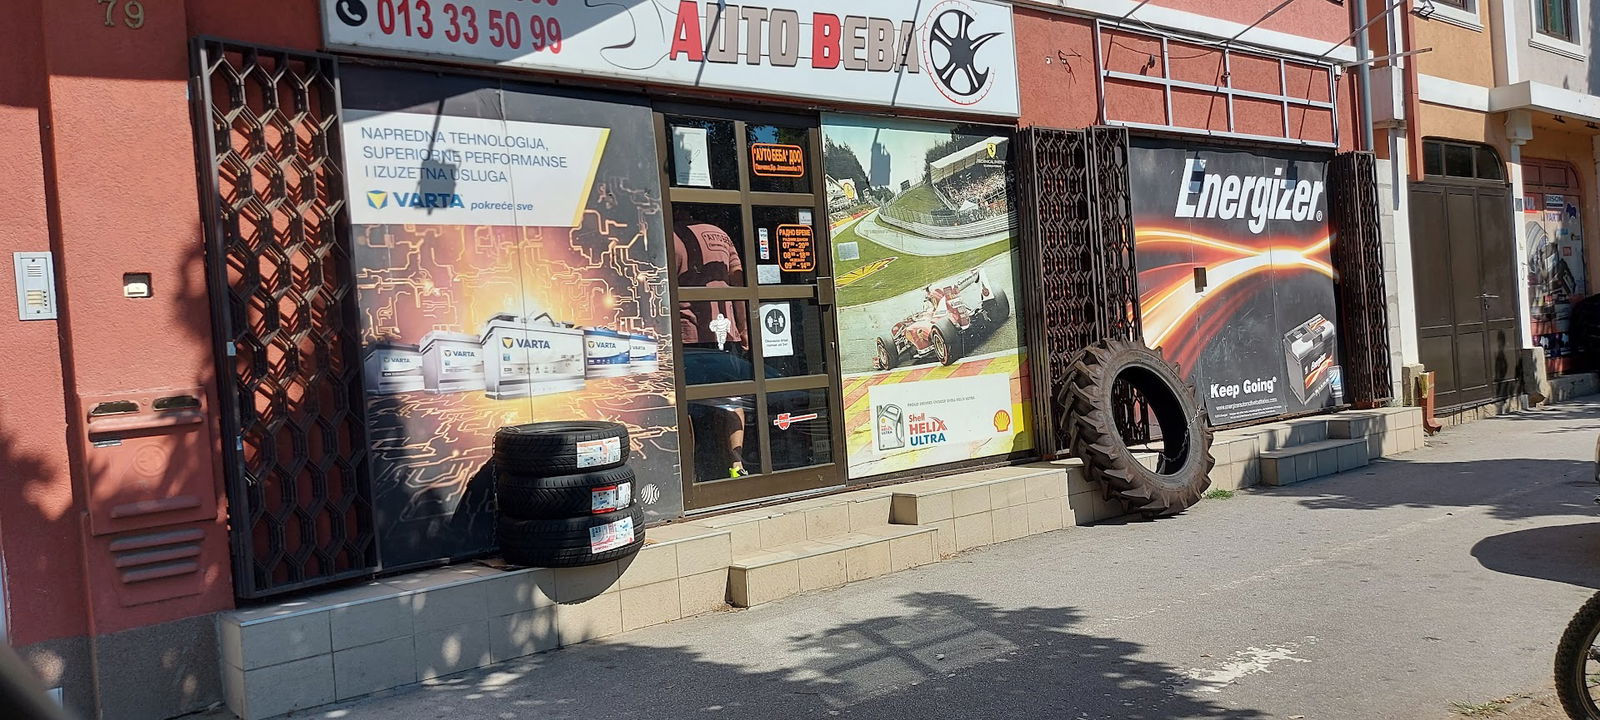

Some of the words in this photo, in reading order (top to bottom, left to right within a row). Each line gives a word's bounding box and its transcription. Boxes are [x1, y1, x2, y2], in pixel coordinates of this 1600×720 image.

[98, 0, 145, 29] 79
[377, 0, 434, 40] 013
[443, 3, 479, 45] 33
[489, 9, 521, 50] 50
[530, 14, 562, 54] 99
[669, 0, 799, 67] AUTO
[811, 12, 920, 74] BEBA
[361, 127, 446, 143] NAPREDNA
[448, 131, 549, 151] TEHNOLOGIJA,
[363, 145, 462, 163] SUPERIORNE
[465, 151, 568, 168] PERFORMANSE
[365, 165, 369, 178] I
[373, 165, 448, 180] IZUZETNA
[450, 168, 508, 182] USLUGA
[392, 191, 465, 209] VARTA
[470, 199, 513, 211] pokreće
[516, 202, 534, 211] sve
[516, 338, 551, 349] VARTA
[596, 341, 616, 349] VARTA
[1210, 383, 1240, 399] Keep
[908, 412, 925, 423] Shell
[909, 417, 948, 435] HELIX
[910, 432, 946, 446] ULTRA
